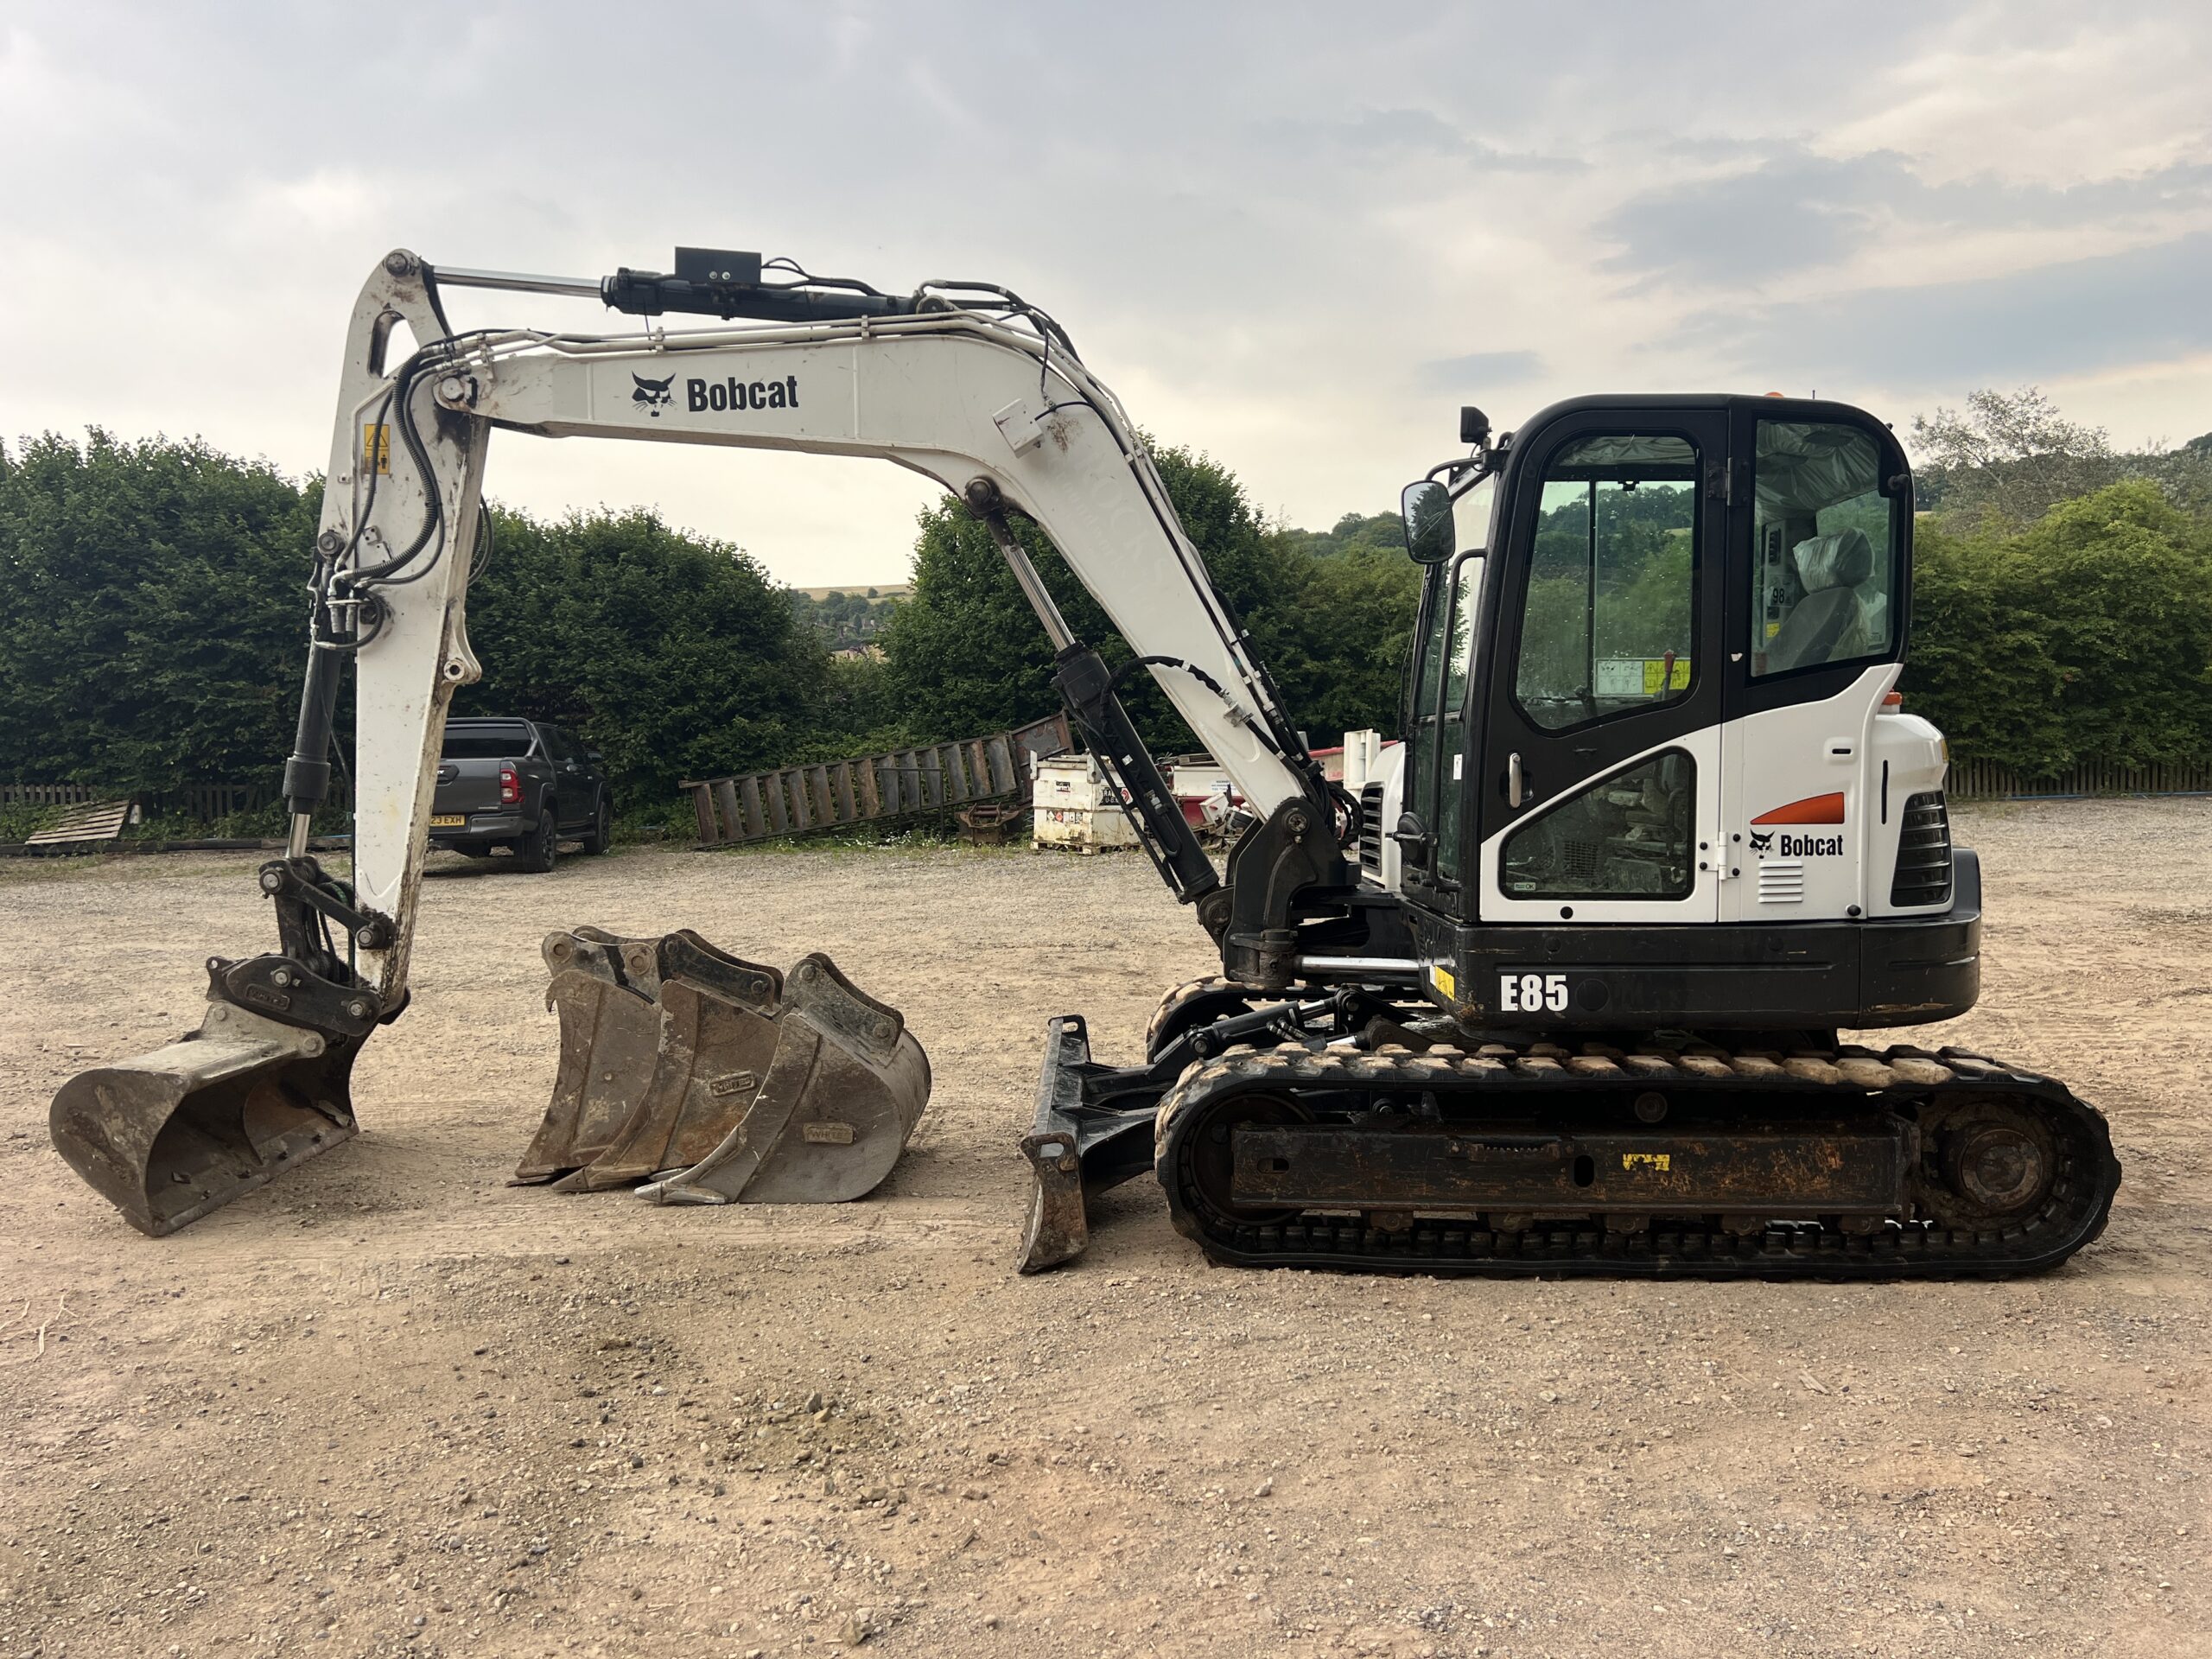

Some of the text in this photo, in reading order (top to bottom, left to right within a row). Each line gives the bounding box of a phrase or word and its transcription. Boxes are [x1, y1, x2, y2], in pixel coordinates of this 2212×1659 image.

[687, 375, 799, 412] Bobcat
[1772, 588, 1785, 604] 98
[443, 816, 461, 824] EXH
[1781, 834, 1843, 856] Bobcat
[1501, 974, 1568, 1012] E85
